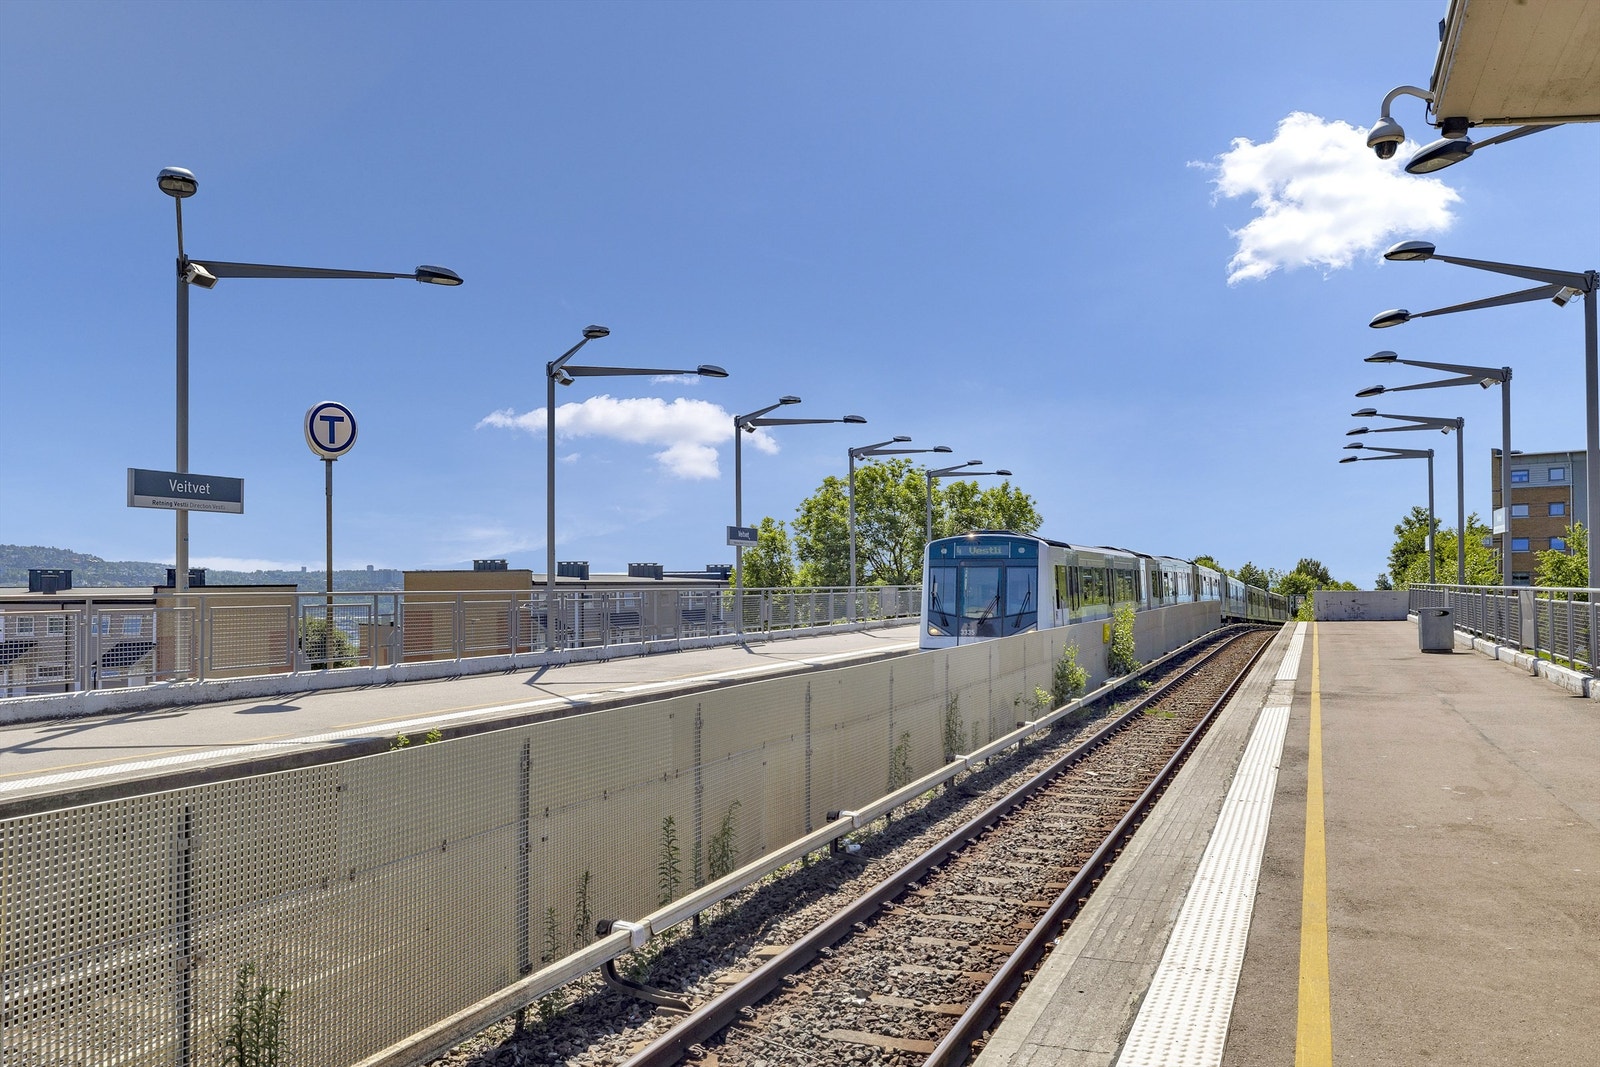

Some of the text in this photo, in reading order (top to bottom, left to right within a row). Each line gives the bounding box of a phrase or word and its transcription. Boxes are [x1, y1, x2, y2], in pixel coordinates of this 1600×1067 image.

[319, 415, 345, 444] T
[169, 479, 211, 495] Veitvet
[151, 499, 173, 508] Retning
